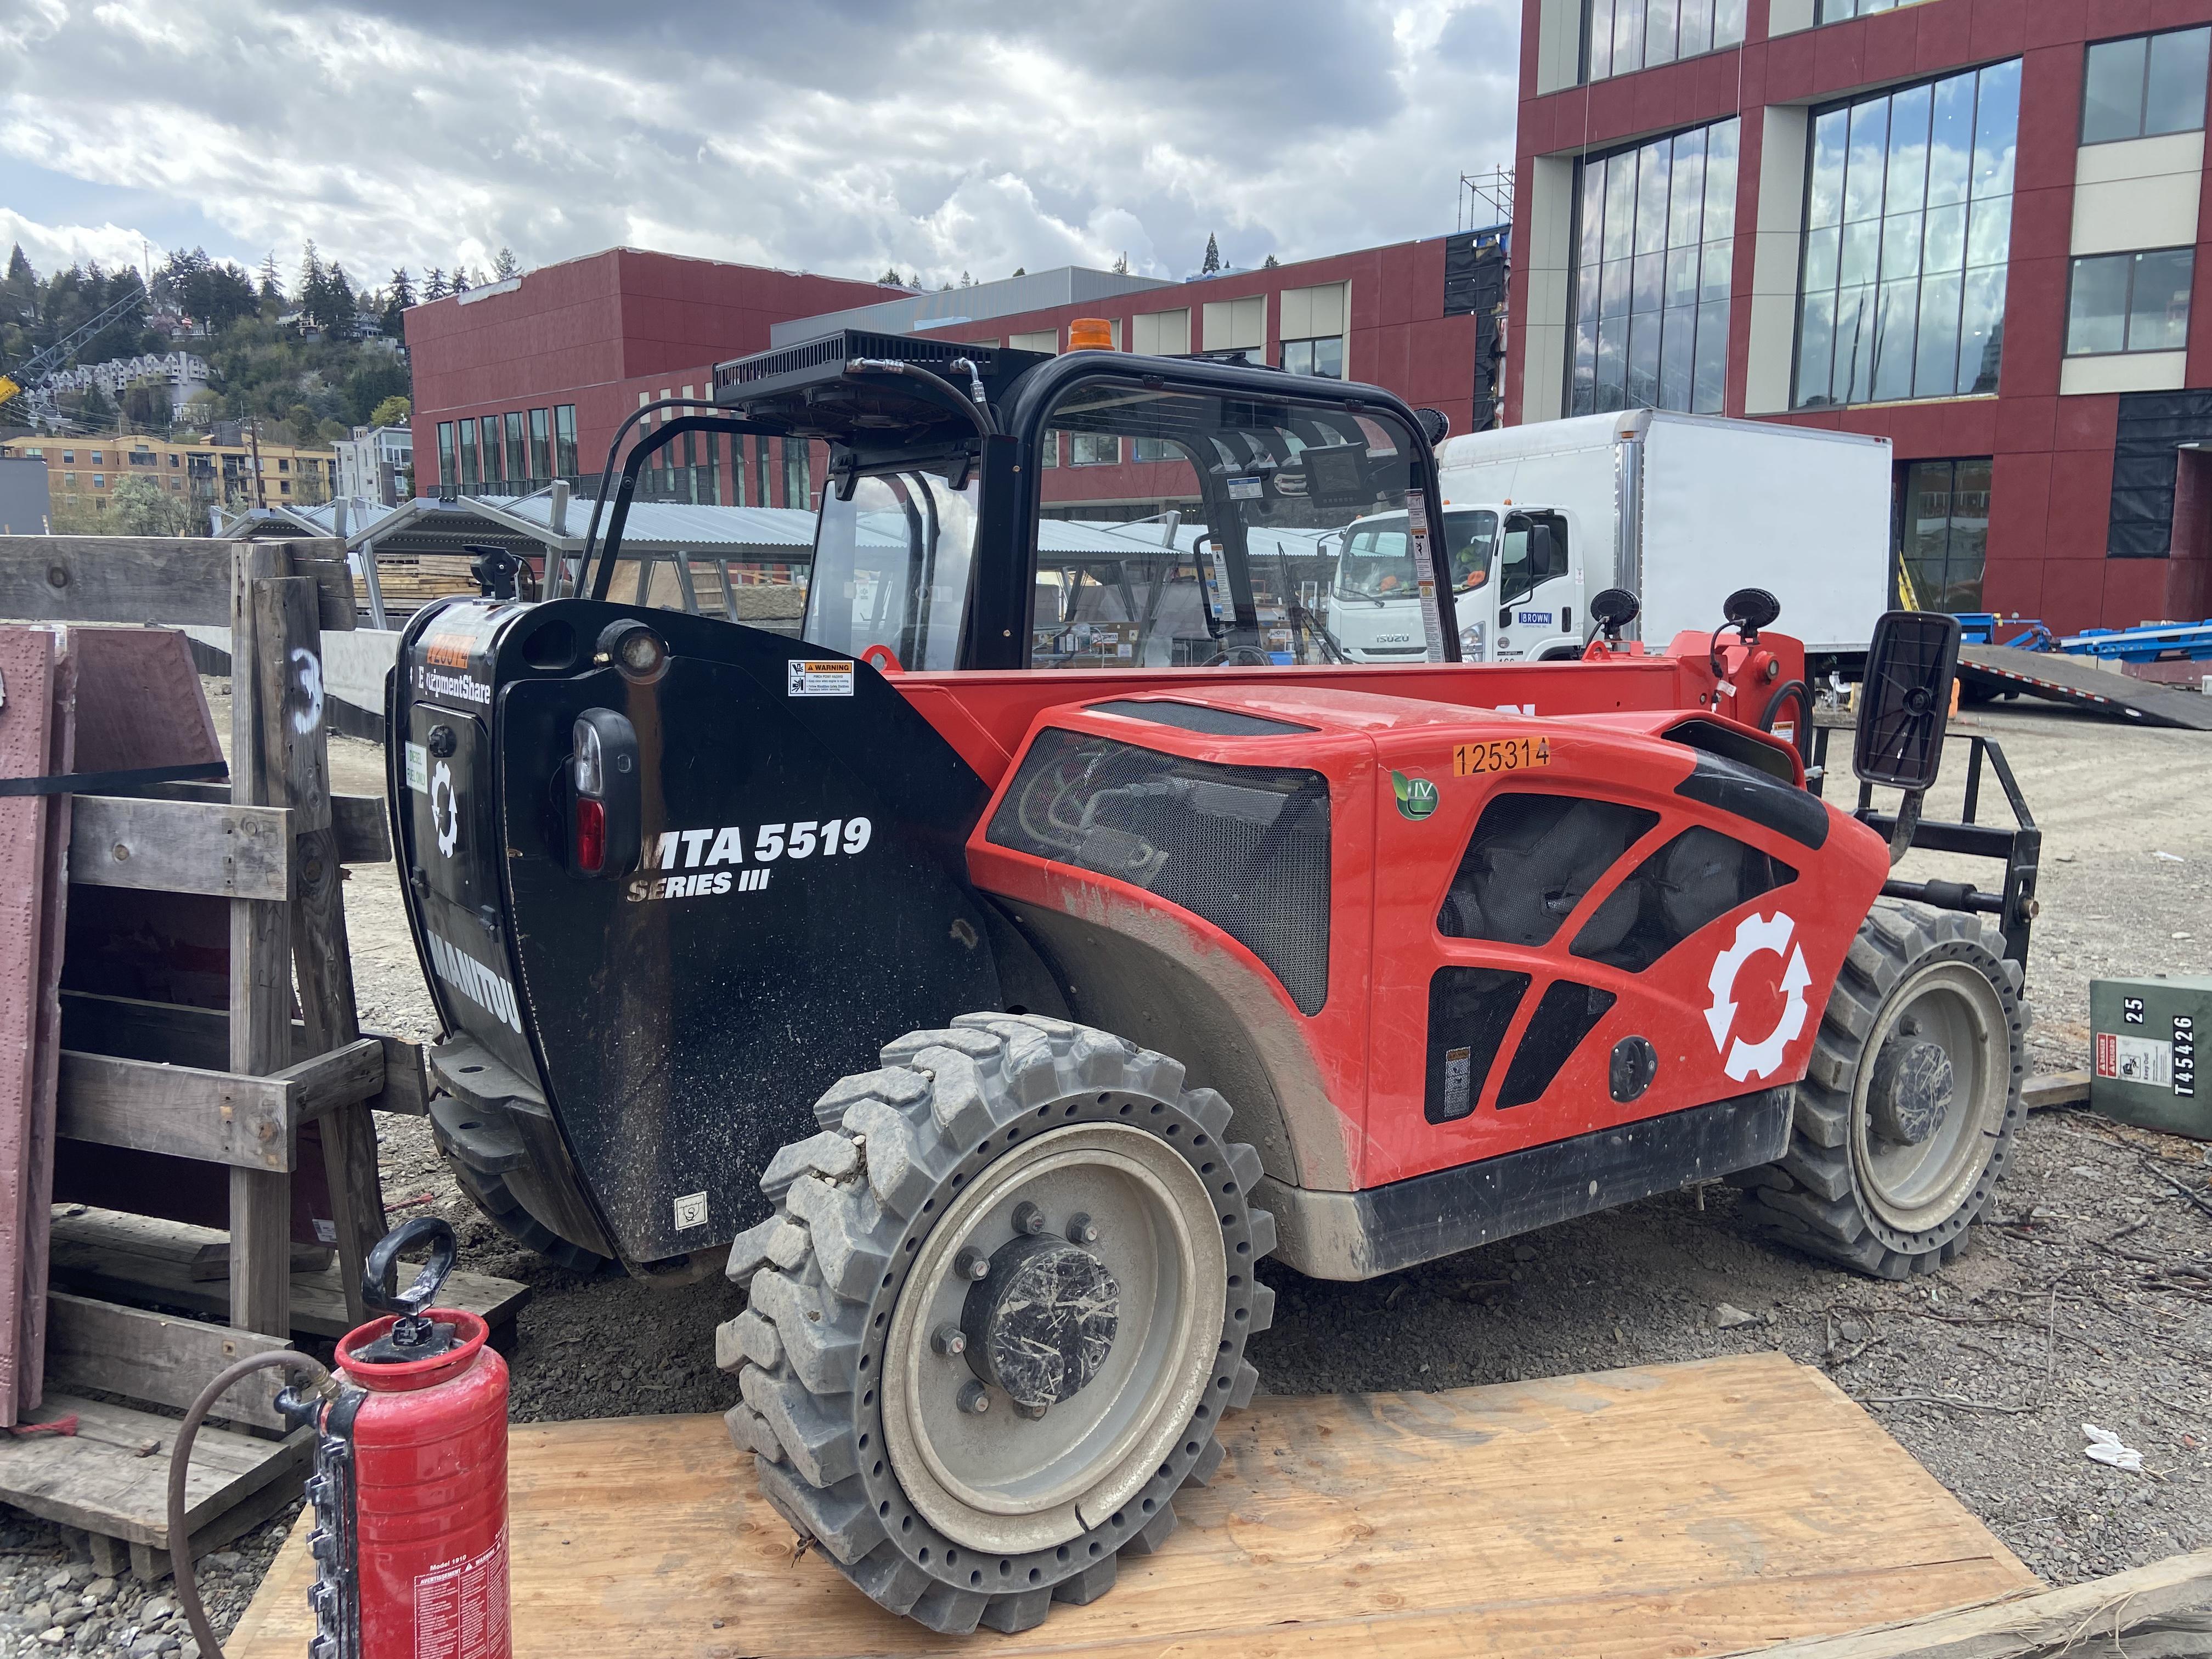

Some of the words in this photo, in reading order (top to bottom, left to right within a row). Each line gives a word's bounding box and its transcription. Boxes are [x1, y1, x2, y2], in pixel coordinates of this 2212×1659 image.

[1522, 613, 1548, 623] BROWN
[1376, 633, 1409, 643] ISUZU
[291, 647, 324, 735] 3
[418, 665, 491, 704] EquipmentShare
[1457, 737, 1549, 775] 125314
[1414, 782, 1433, 798] IV
[635, 827, 743, 871] MTA
[754, 817, 872, 862] 5519
[627, 872, 732, 902] SERIES
[738, 868, 771, 892] III
[427, 929, 522, 1034] MANITOU
[2125, 998, 2143, 1023] 25
[2174, 1017, 2194, 1095] T45426
[420, 1568, 461, 1585] AVERTISSEMENT
[475, 1548, 495, 1565] WARNING
[430, 1562, 450, 1571] Model
